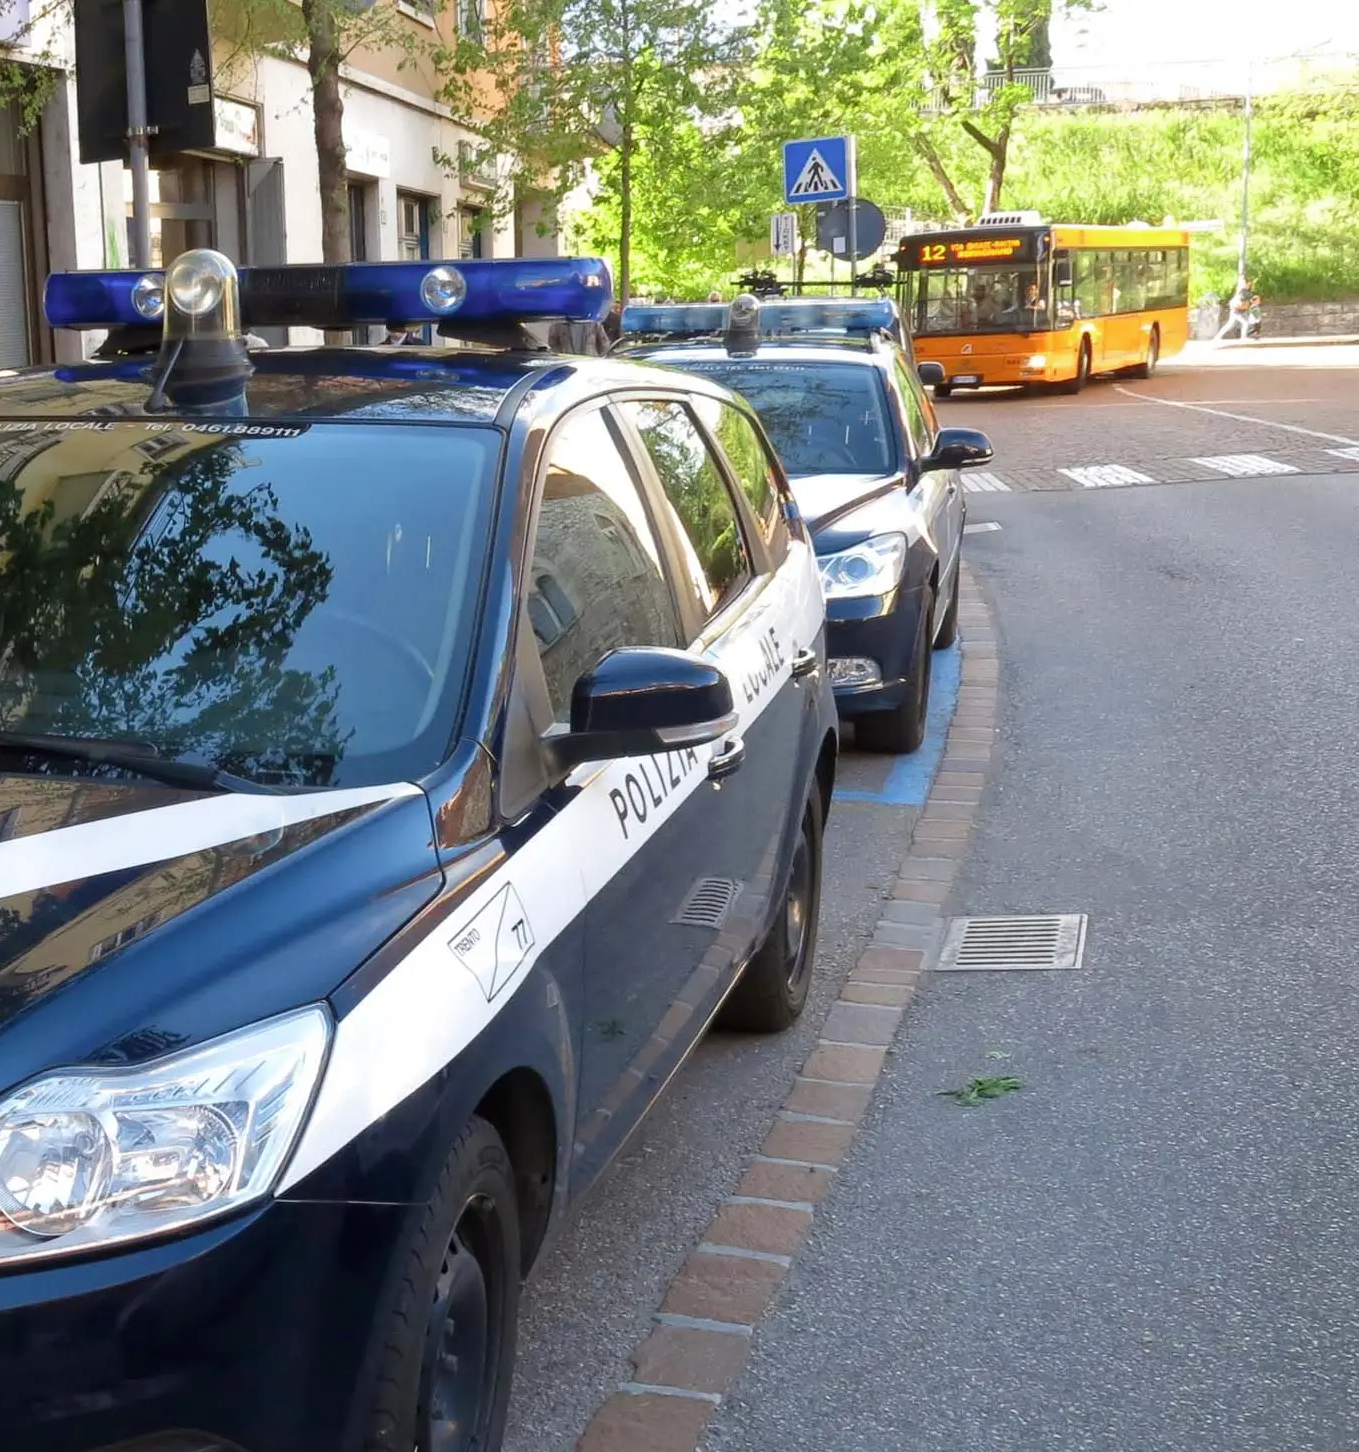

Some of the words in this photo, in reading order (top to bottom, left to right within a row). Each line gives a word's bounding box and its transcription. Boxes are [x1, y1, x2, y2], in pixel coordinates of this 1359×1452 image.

[923, 245, 946, 261] 12
[44, 422, 116, 431] LOCALE
[144, 423, 171, 431] Tel.
[181, 423, 301, 437] 0461.889111
[454, 928, 481, 957] TRENTO
[511, 918, 528, 951] 77
